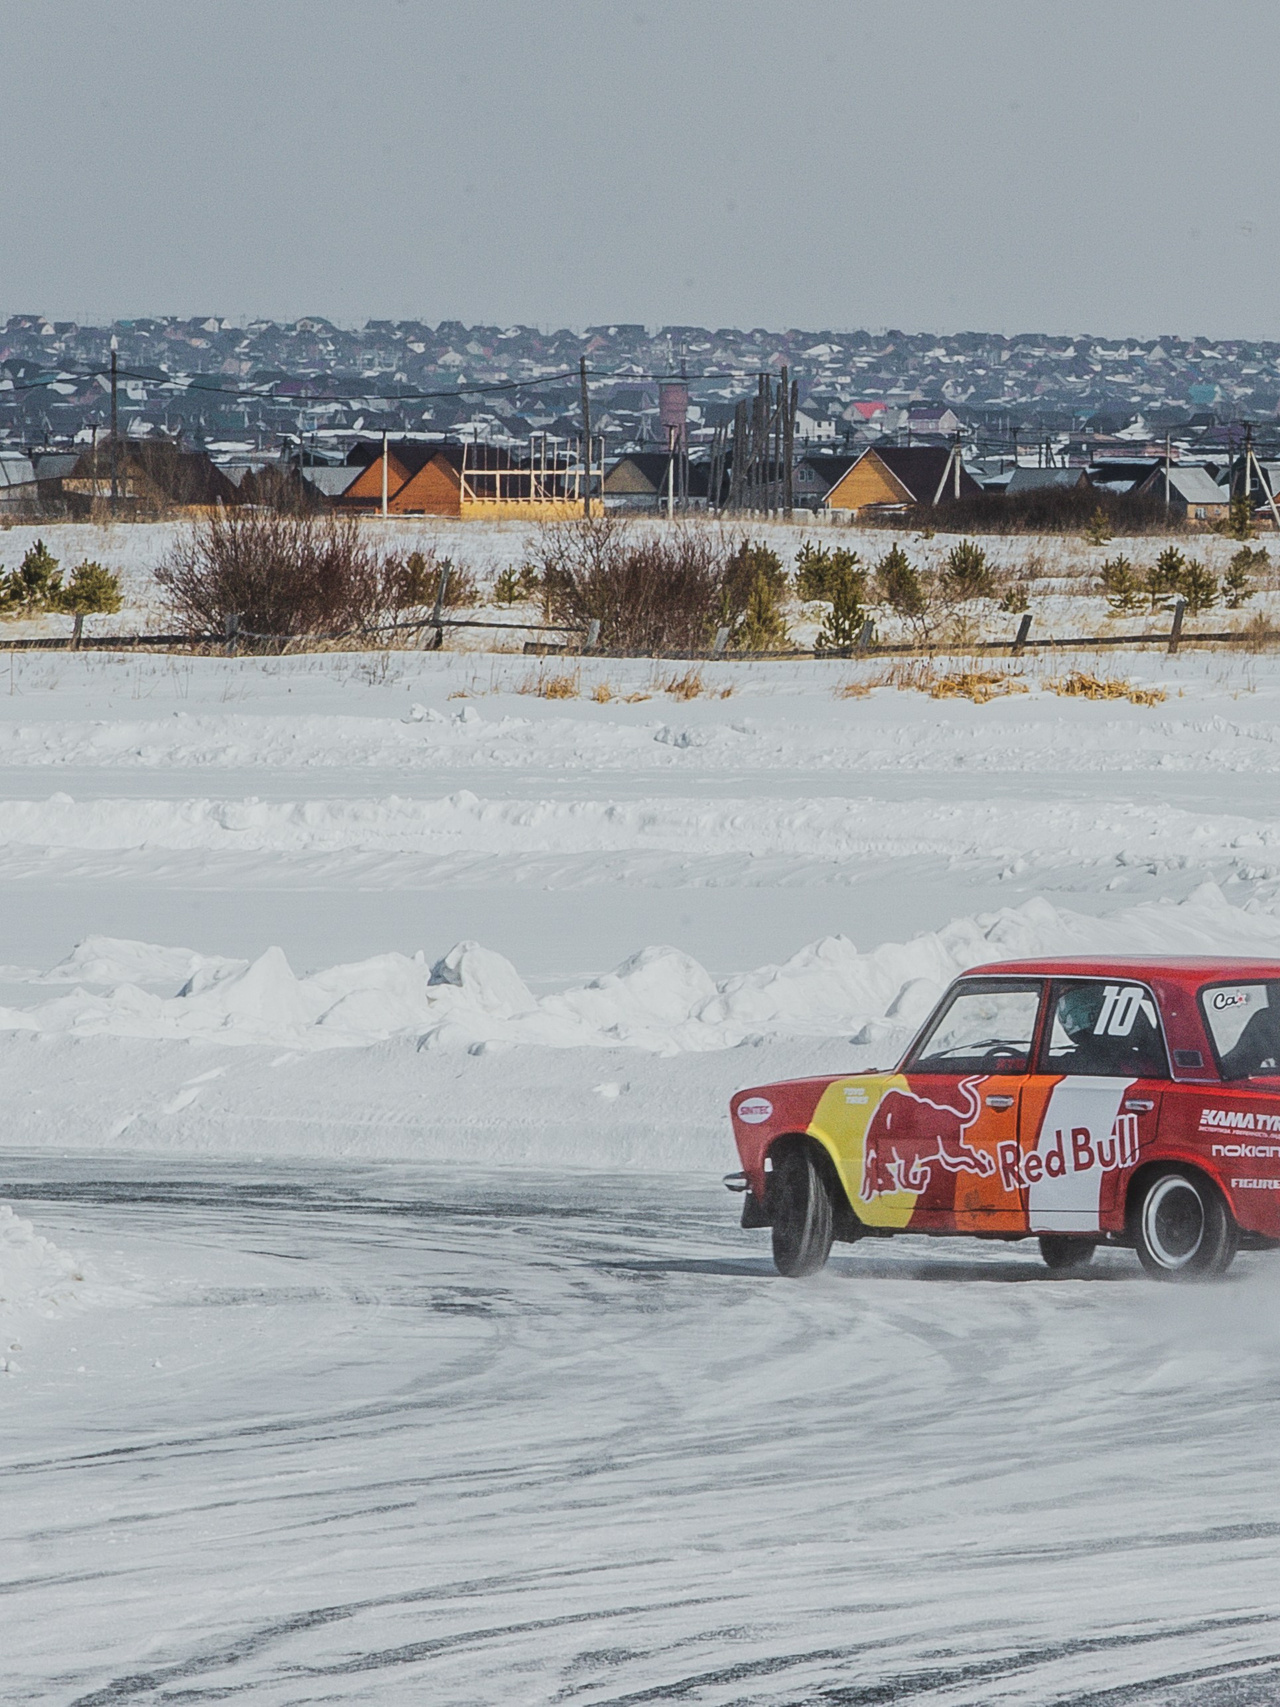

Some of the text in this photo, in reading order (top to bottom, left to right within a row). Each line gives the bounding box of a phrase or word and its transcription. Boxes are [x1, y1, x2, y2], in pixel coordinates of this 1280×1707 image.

[1093, 985, 1144, 1037] 10
[739, 1105, 770, 1116] SINTEC
[1200, 1109, 1255, 1129] KAMA
[997, 1113, 1139, 1192] Red Bull
